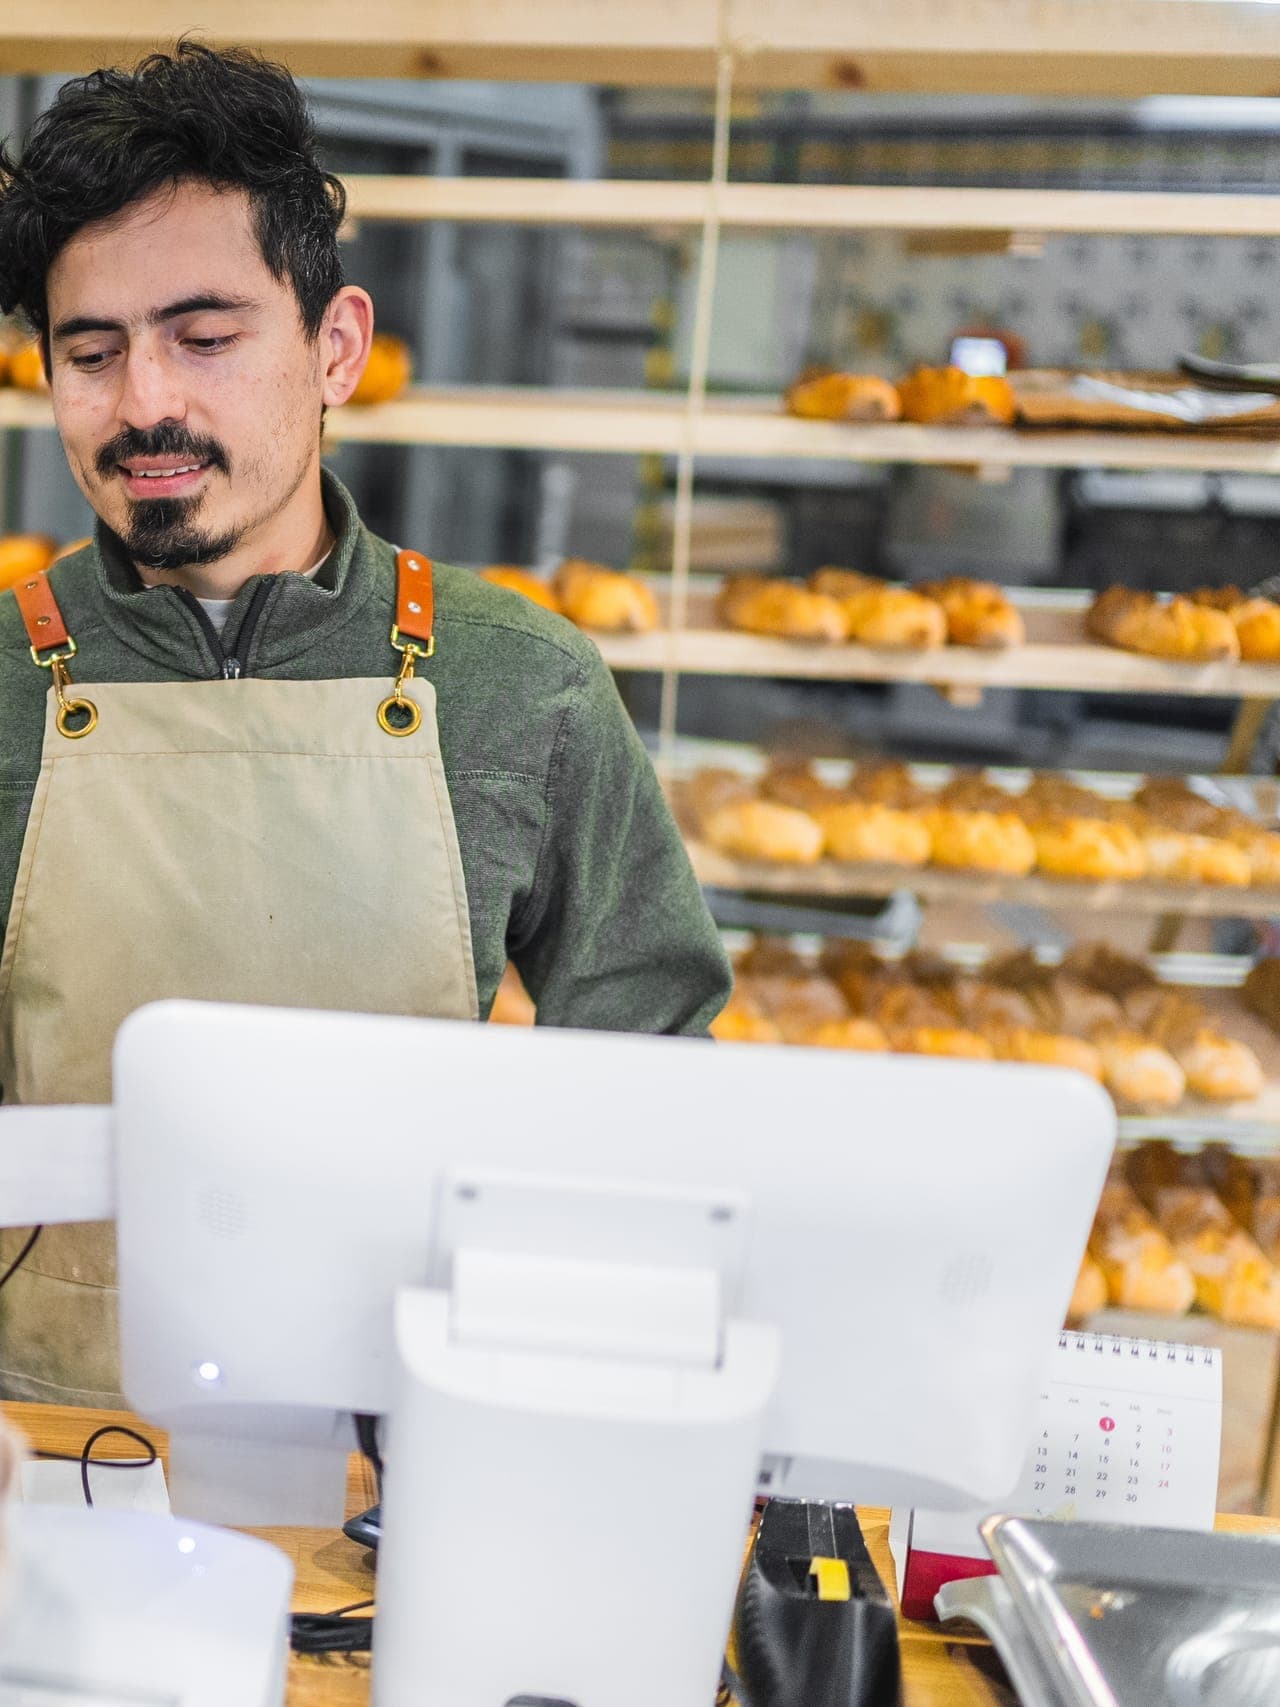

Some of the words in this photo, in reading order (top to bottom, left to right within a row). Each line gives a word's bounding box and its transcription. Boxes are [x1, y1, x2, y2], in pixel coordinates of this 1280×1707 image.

[1042, 1430, 1048, 1438] 6
[1073, 1433, 1079, 1442] 7
[1104, 1438, 1110, 1446] 8
[1135, 1441, 1141, 1450] 9
[1161, 1444, 1172, 1454] 10
[1136, 1424, 1142, 1432] 2
[1168, 1428, 1173, 1436] 3
[1038, 1447, 1047, 1456] 13
[1068, 1451, 1078, 1459] 14
[1099, 1455, 1109, 1464] 15
[1129, 1458, 1139, 1467] 16
[1160, 1462, 1170, 1471] 17
[1035, 1464, 1046, 1473] 20
[1066, 1468, 1076, 1476] 21
[1096, 1472, 1108, 1480] 22
[1127, 1476, 1138, 1484] 23
[1158, 1480, 1169, 1488] 24
[1034, 1481, 1046, 1490] 27
[1064, 1486, 1076, 1494] 28
[1096, 1489, 1106, 1498] 29
[1125, 1494, 1137, 1502] 30
